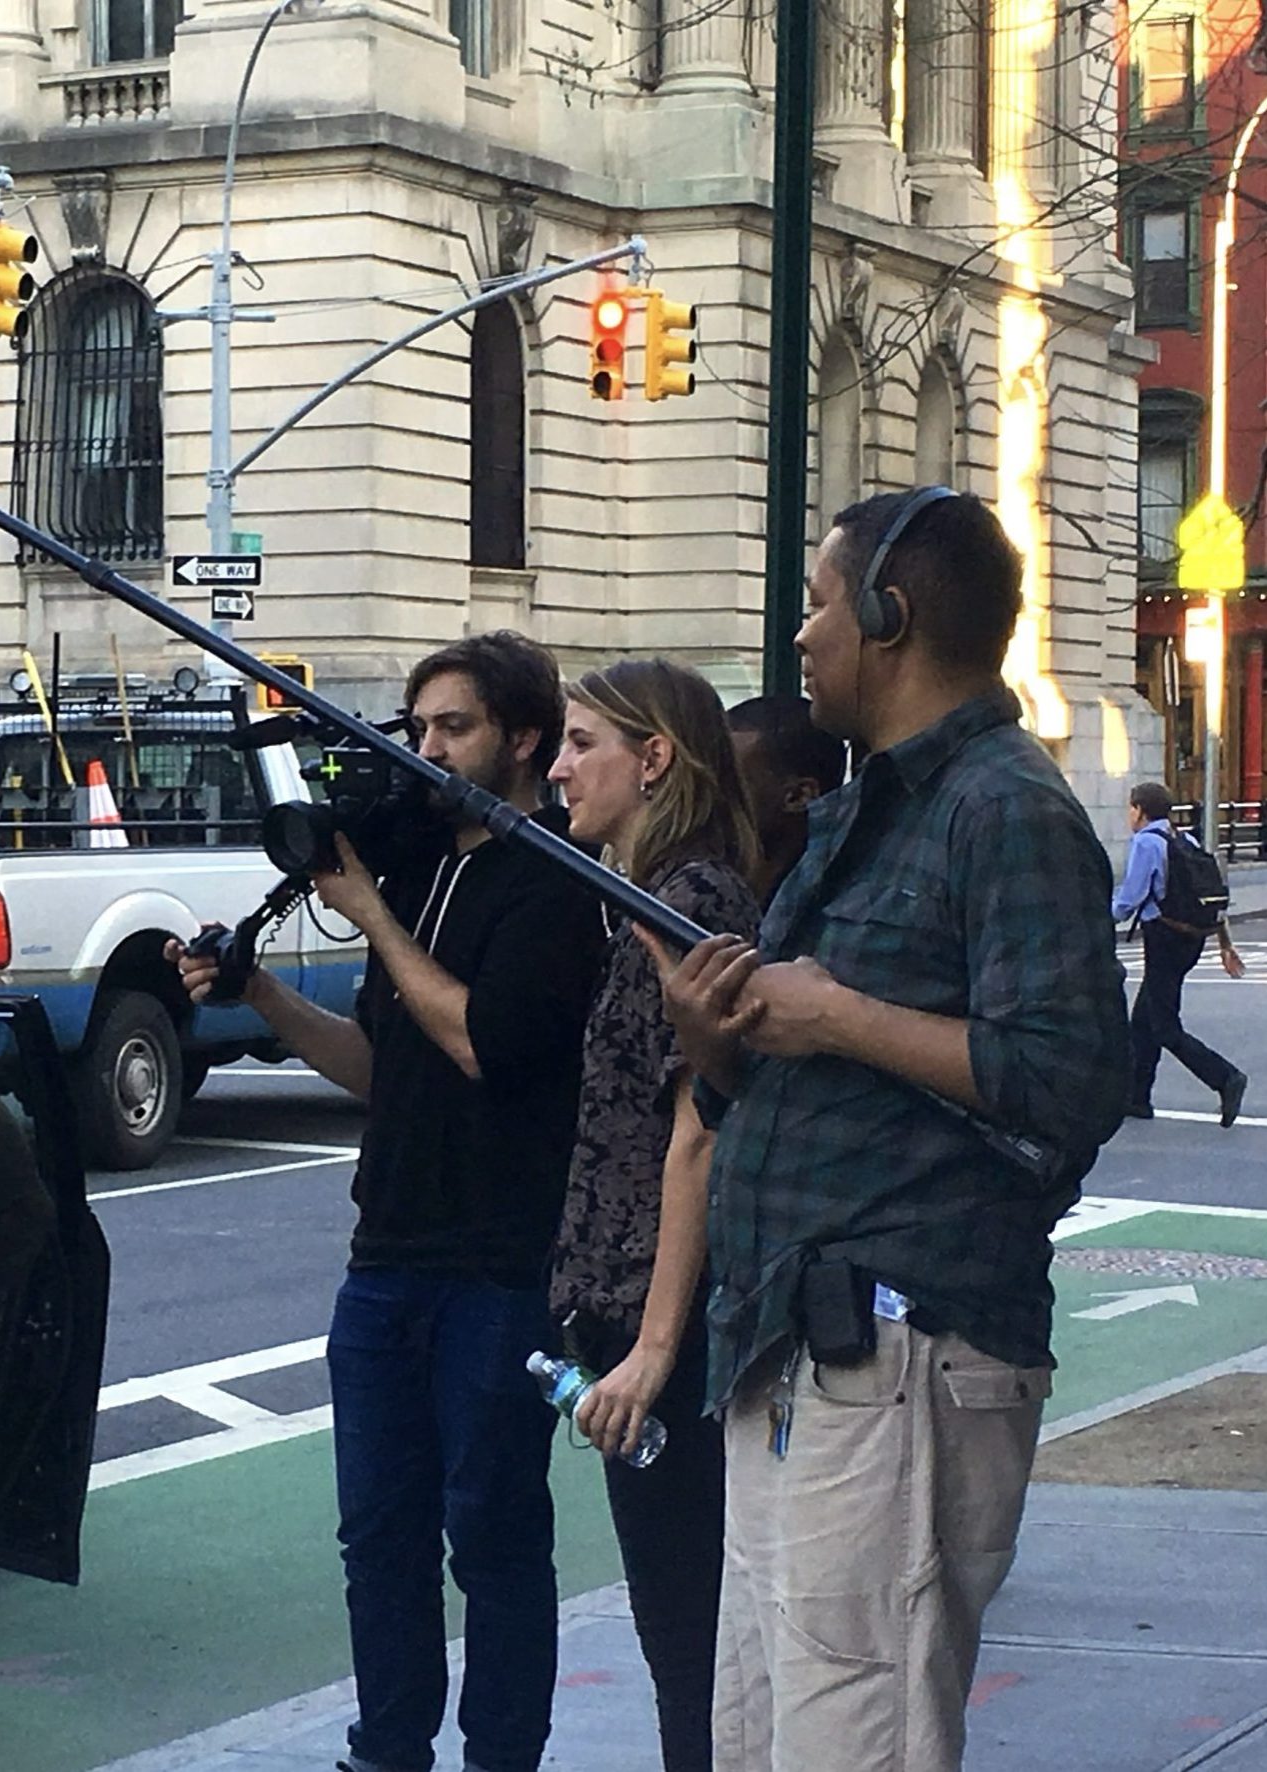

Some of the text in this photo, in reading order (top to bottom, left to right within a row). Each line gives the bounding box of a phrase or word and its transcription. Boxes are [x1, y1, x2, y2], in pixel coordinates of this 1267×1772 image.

[196, 564, 252, 577] ONE WAY
[218, 598, 231, 610] ONE
